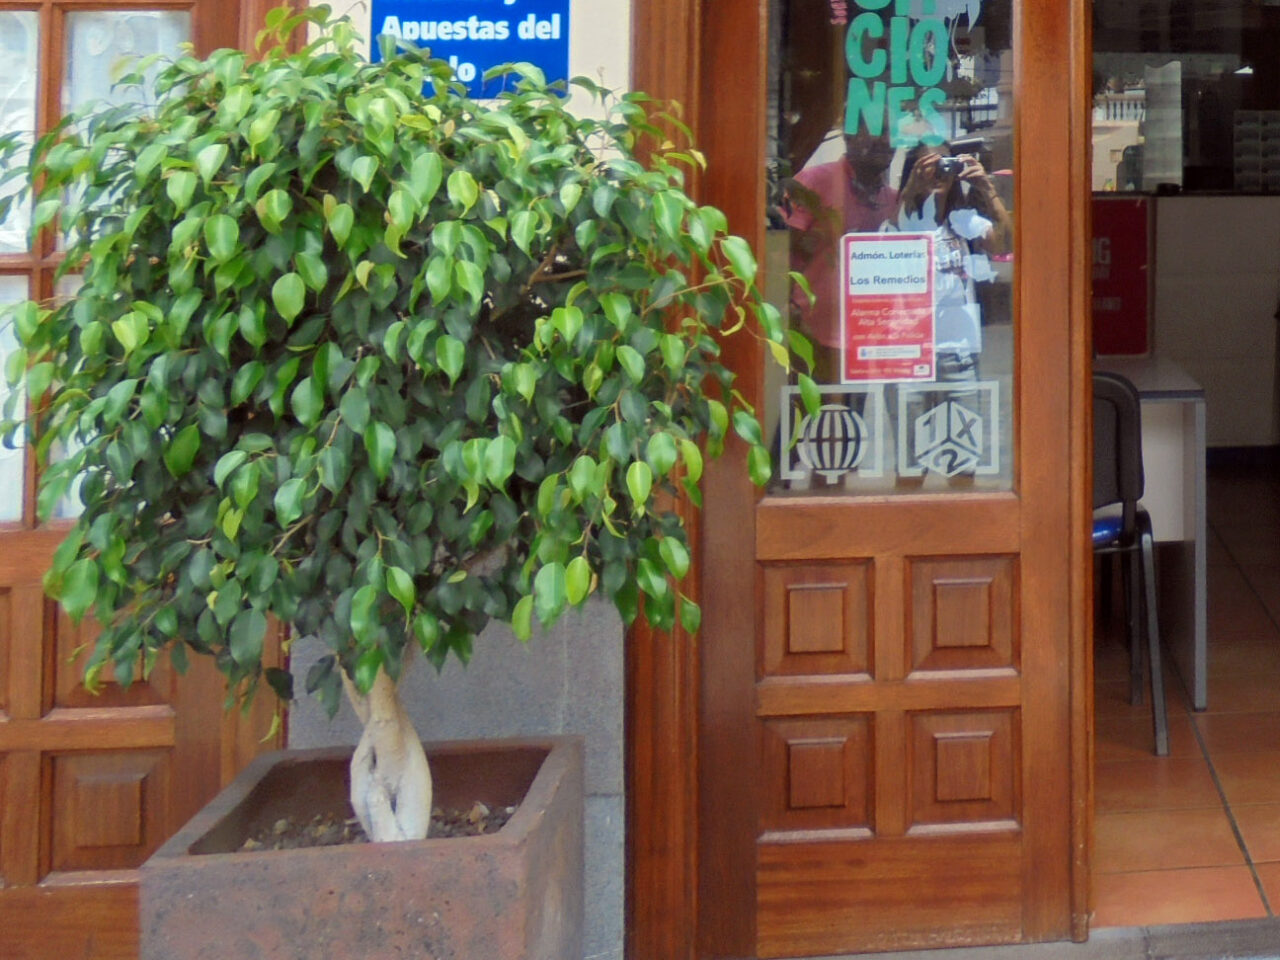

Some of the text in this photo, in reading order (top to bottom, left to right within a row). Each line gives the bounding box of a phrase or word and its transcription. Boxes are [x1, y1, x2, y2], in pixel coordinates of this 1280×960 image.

[517, 13, 561, 40] del
[850, 274, 926, 286] Los Remedios
